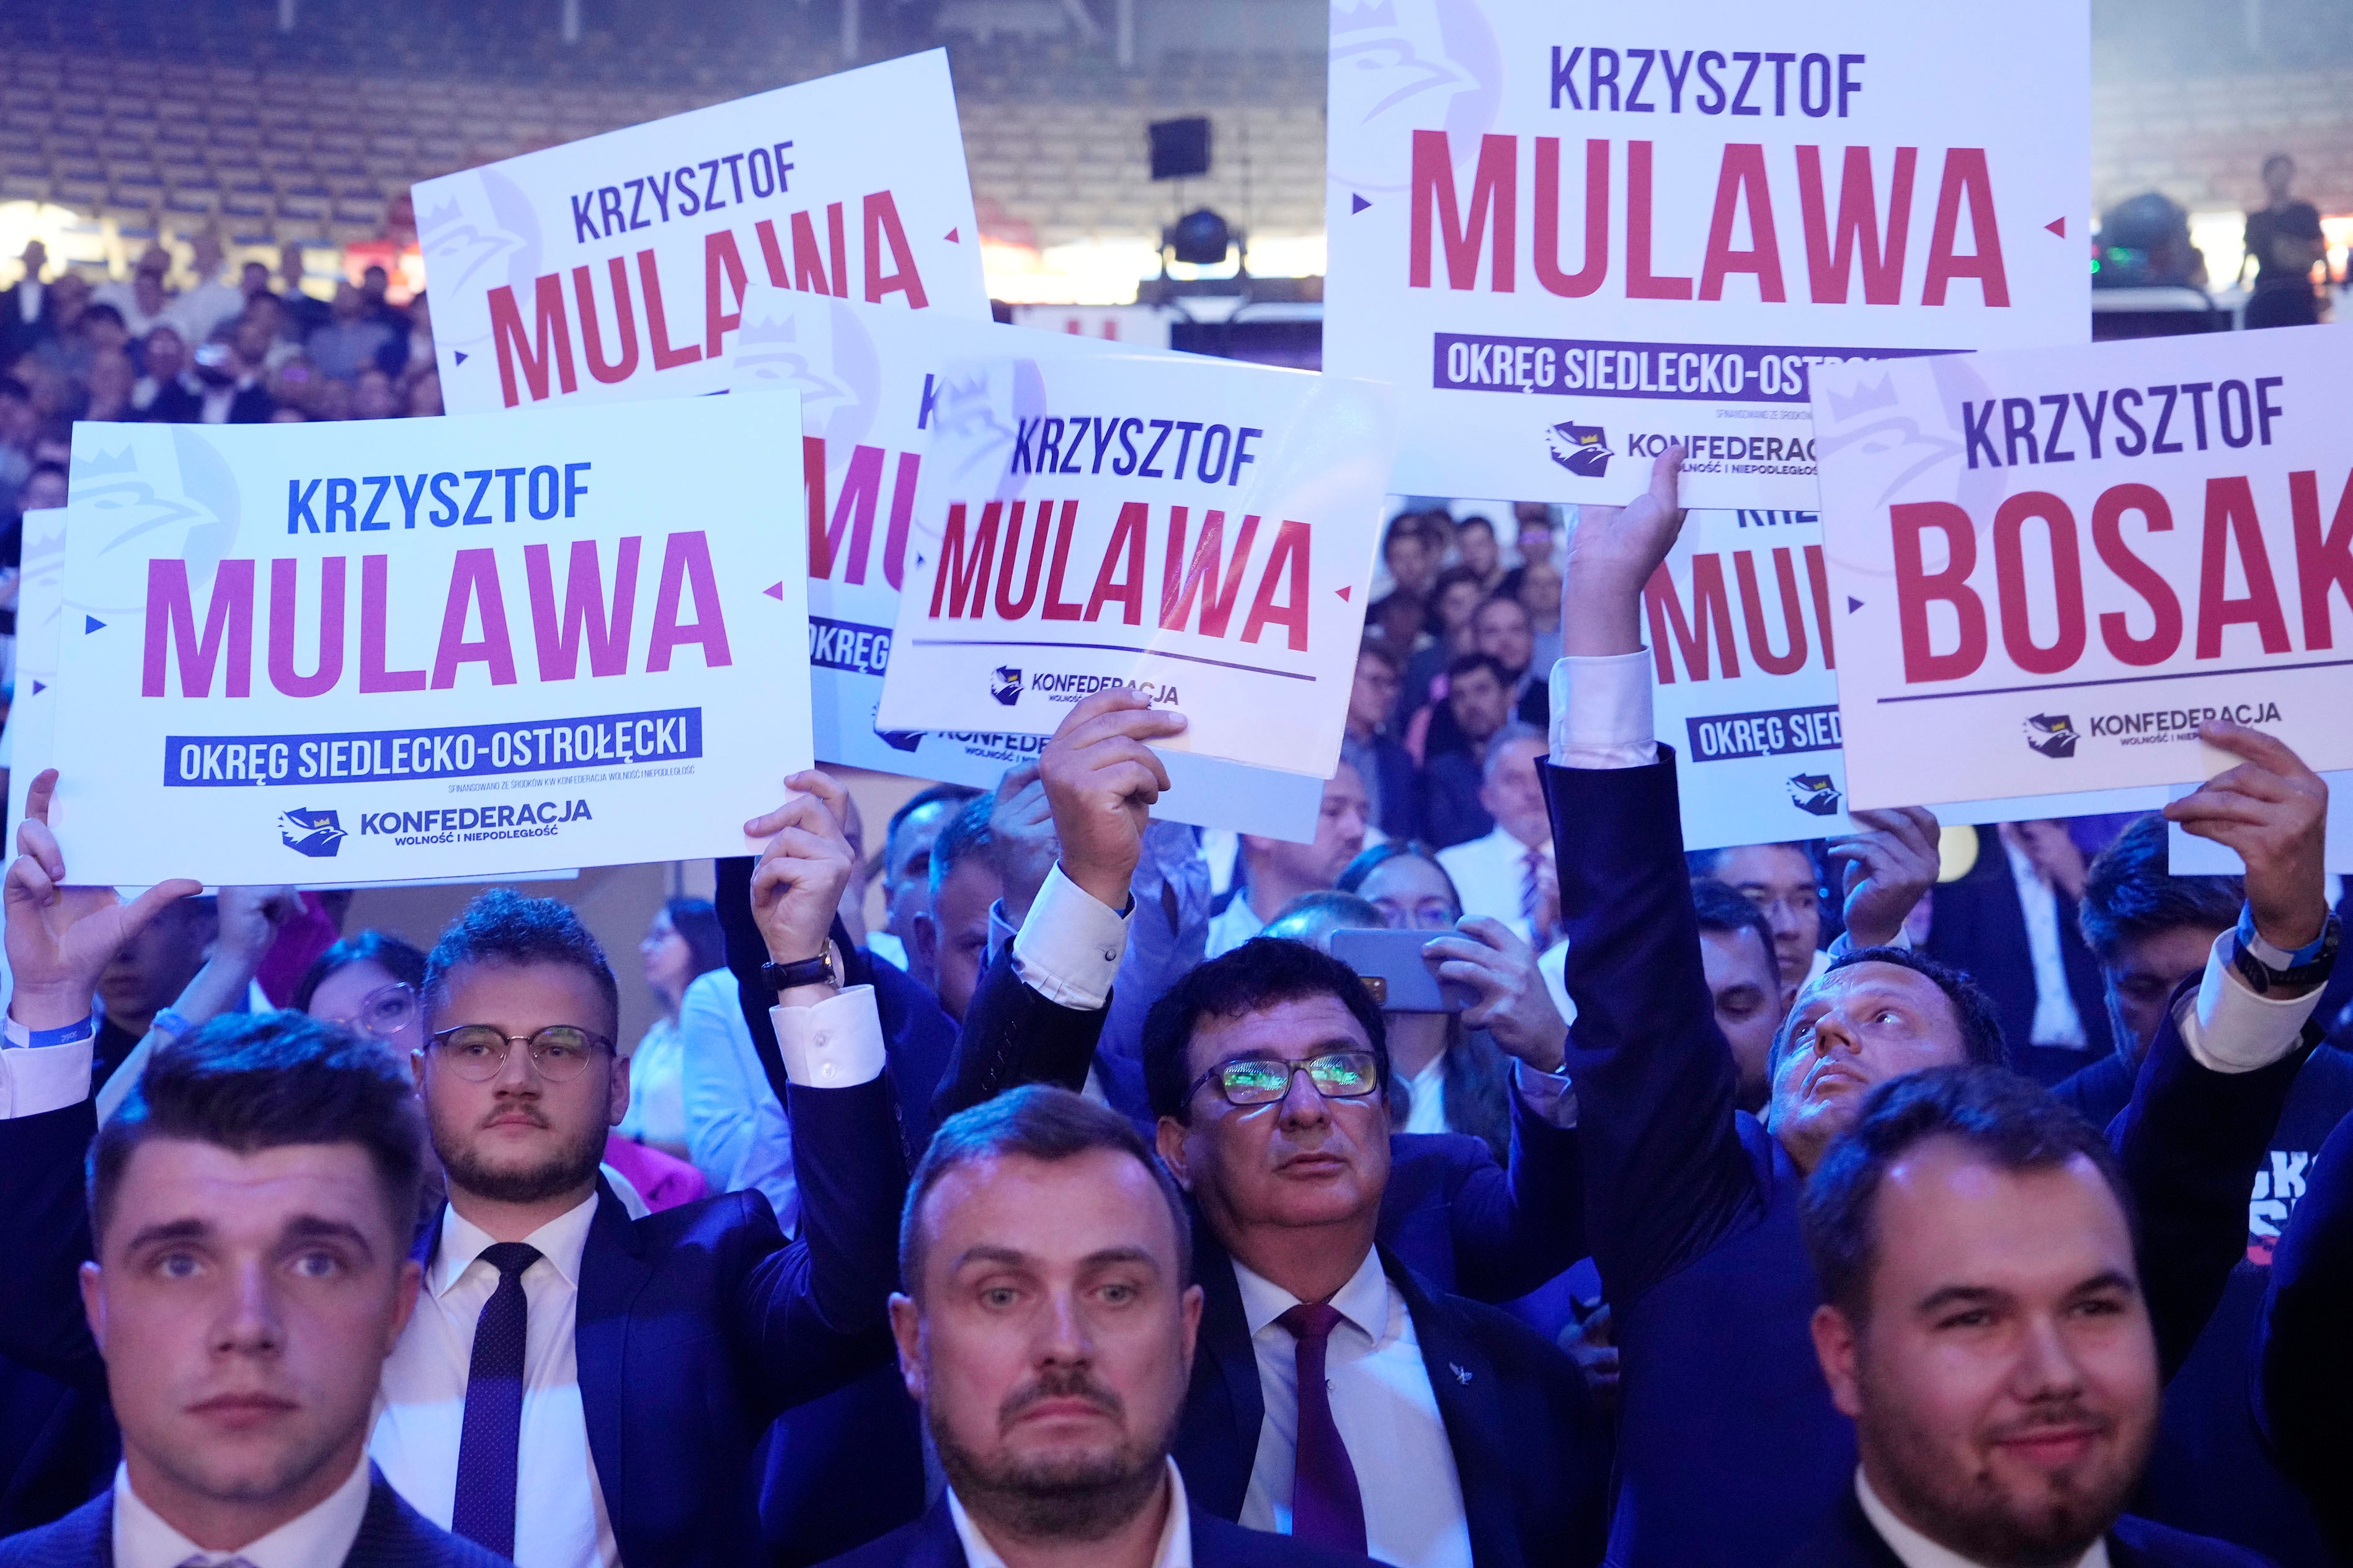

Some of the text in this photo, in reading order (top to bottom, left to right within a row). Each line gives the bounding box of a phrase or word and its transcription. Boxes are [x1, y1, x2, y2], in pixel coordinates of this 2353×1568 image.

[1550, 45, 1865, 118] KRZYSZTOF
[571, 141, 794, 243] KRZYSZTOF
[1408, 130, 2011, 308] MULAWA
[487, 190, 929, 408] MULAWA
[1446, 342, 1555, 395] OKRĘG
[1010, 417, 1263, 486] KRZYSZTOF
[1962, 377, 2284, 470] KRZYSZTOF
[288, 462, 592, 534] KRZYSZTOF
[929, 500, 1312, 652] MULAWA
[1889, 466, 2353, 684] BOSAK
[141, 530, 732, 698] MULAWA
[180, 715, 687, 786] OKRĘG SIEDLECKO-OSTROŁĘCKI
[1699, 717, 1786, 756] OKRĘG
[448, 782, 500, 794] SFINANSOWANO
[501, 781, 509, 789] ZE
[510, 777, 543, 789] ŚRODKÓW
[545, 777, 556, 786] KW
[558, 773, 607, 785] KONFEDERACJA
[609, 769, 640, 781] WOLNOŚĆ
[644, 764, 695, 778] NIEPODLEGŁOŚĆ
[360, 799, 593, 835] KONFEDERACJA
[394, 825, 558, 846] WOLNOŚĆ I NIEPODLEGŁOŚĆ
